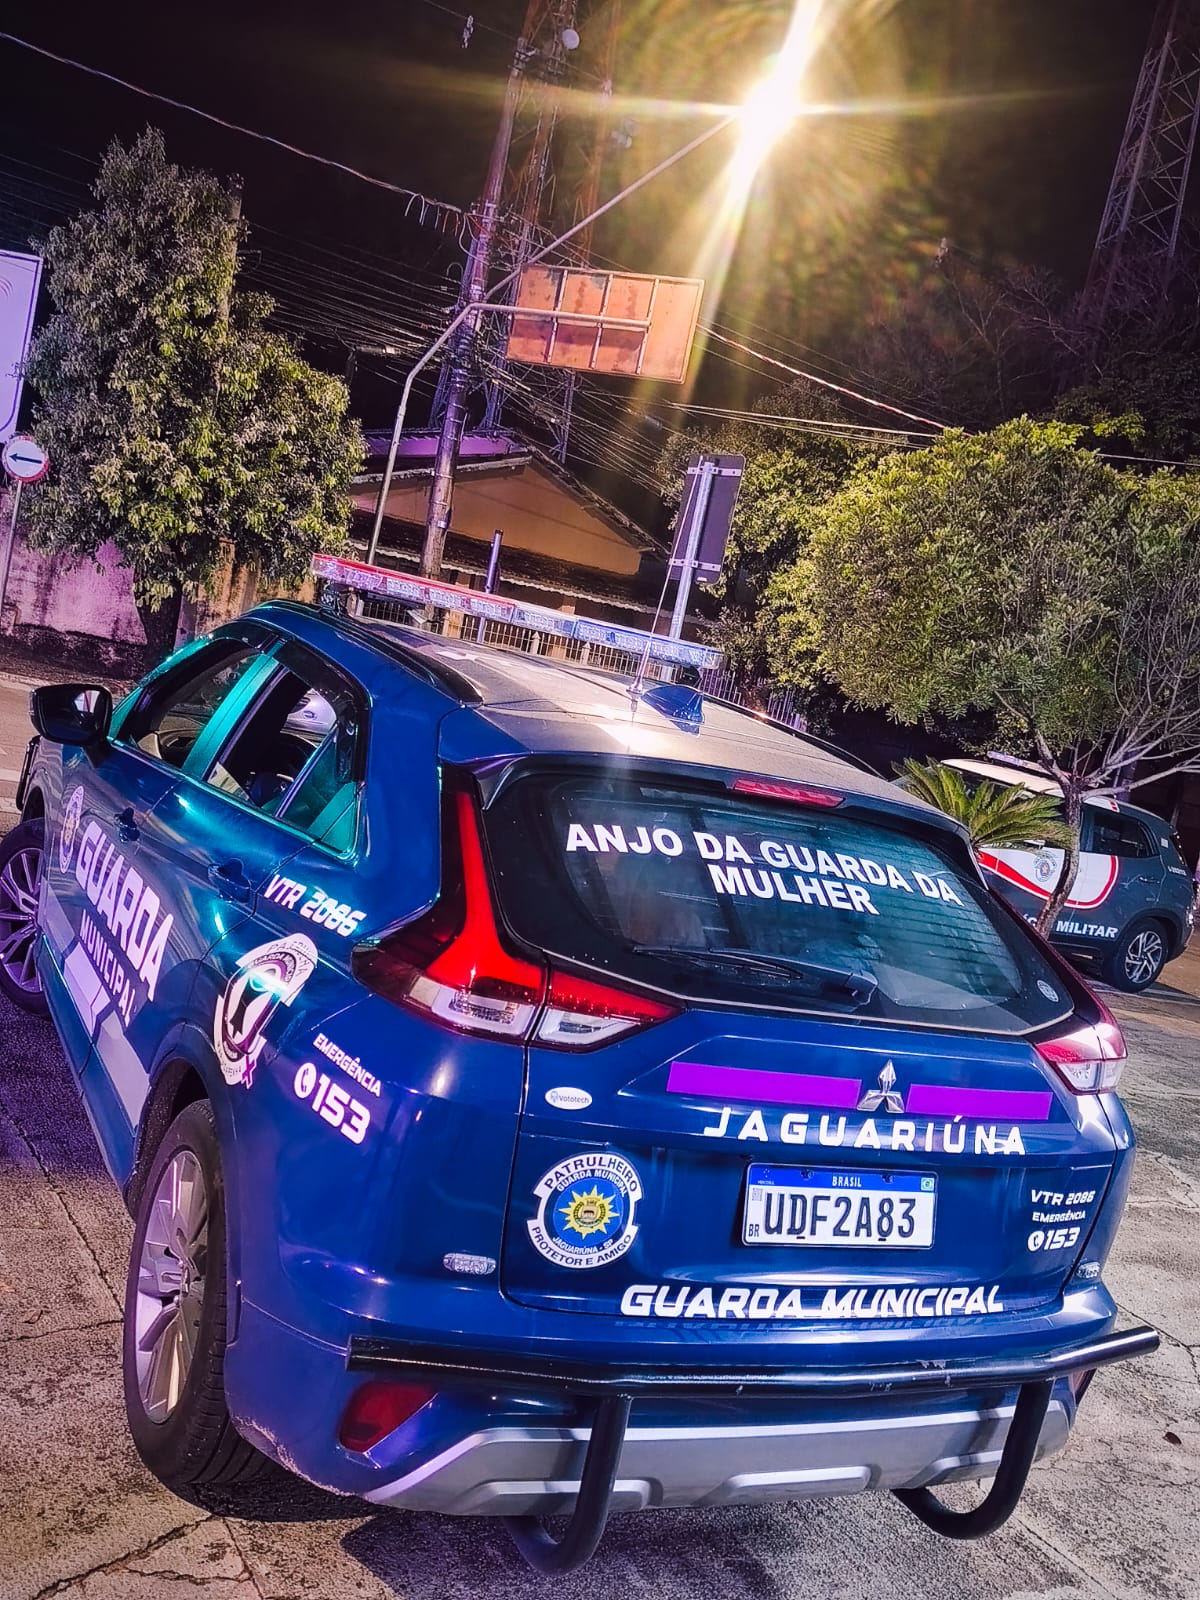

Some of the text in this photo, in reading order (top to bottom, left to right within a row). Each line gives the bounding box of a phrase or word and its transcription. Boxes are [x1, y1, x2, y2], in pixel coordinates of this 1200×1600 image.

[566, 823, 965, 907] ANJO DA GUARDA DA
[264, 874, 367, 937] VTR 2086
[707, 863, 880, 915] MULHER
[76, 821, 174, 1001] GUARDA
[1056, 920, 1119, 938] MILITAR
[79, 909, 135, 1027] MUNICIPAL
[312, 1033, 382, 1097] EMERGÊNCIA
[311, 1073, 371, 1145] 153
[703, 1107, 1026, 1155] JAGUARIÚNA
[544, 1156, 638, 1193] PATRULHEIRO
[556, 1168, 628, 1198] GUARDA MUNICIPAL
[832, 1175, 862, 1188] BRASIL
[764, 1192, 917, 1239] UDF2A83
[1031, 1189, 1096, 1206] VTR 2086
[1032, 1209, 1086, 1223] EMERGÊNCIA
[531, 1226, 632, 1267] PROTETOR E AMIGO
[552, 1236, 599, 1256] JAGUARIÚNA
[748, 1223, 760, 1238] BR
[1044, 1226, 1081, 1250] 153
[619, 1284, 1004, 1319] GUARDA MUNICIPAL
